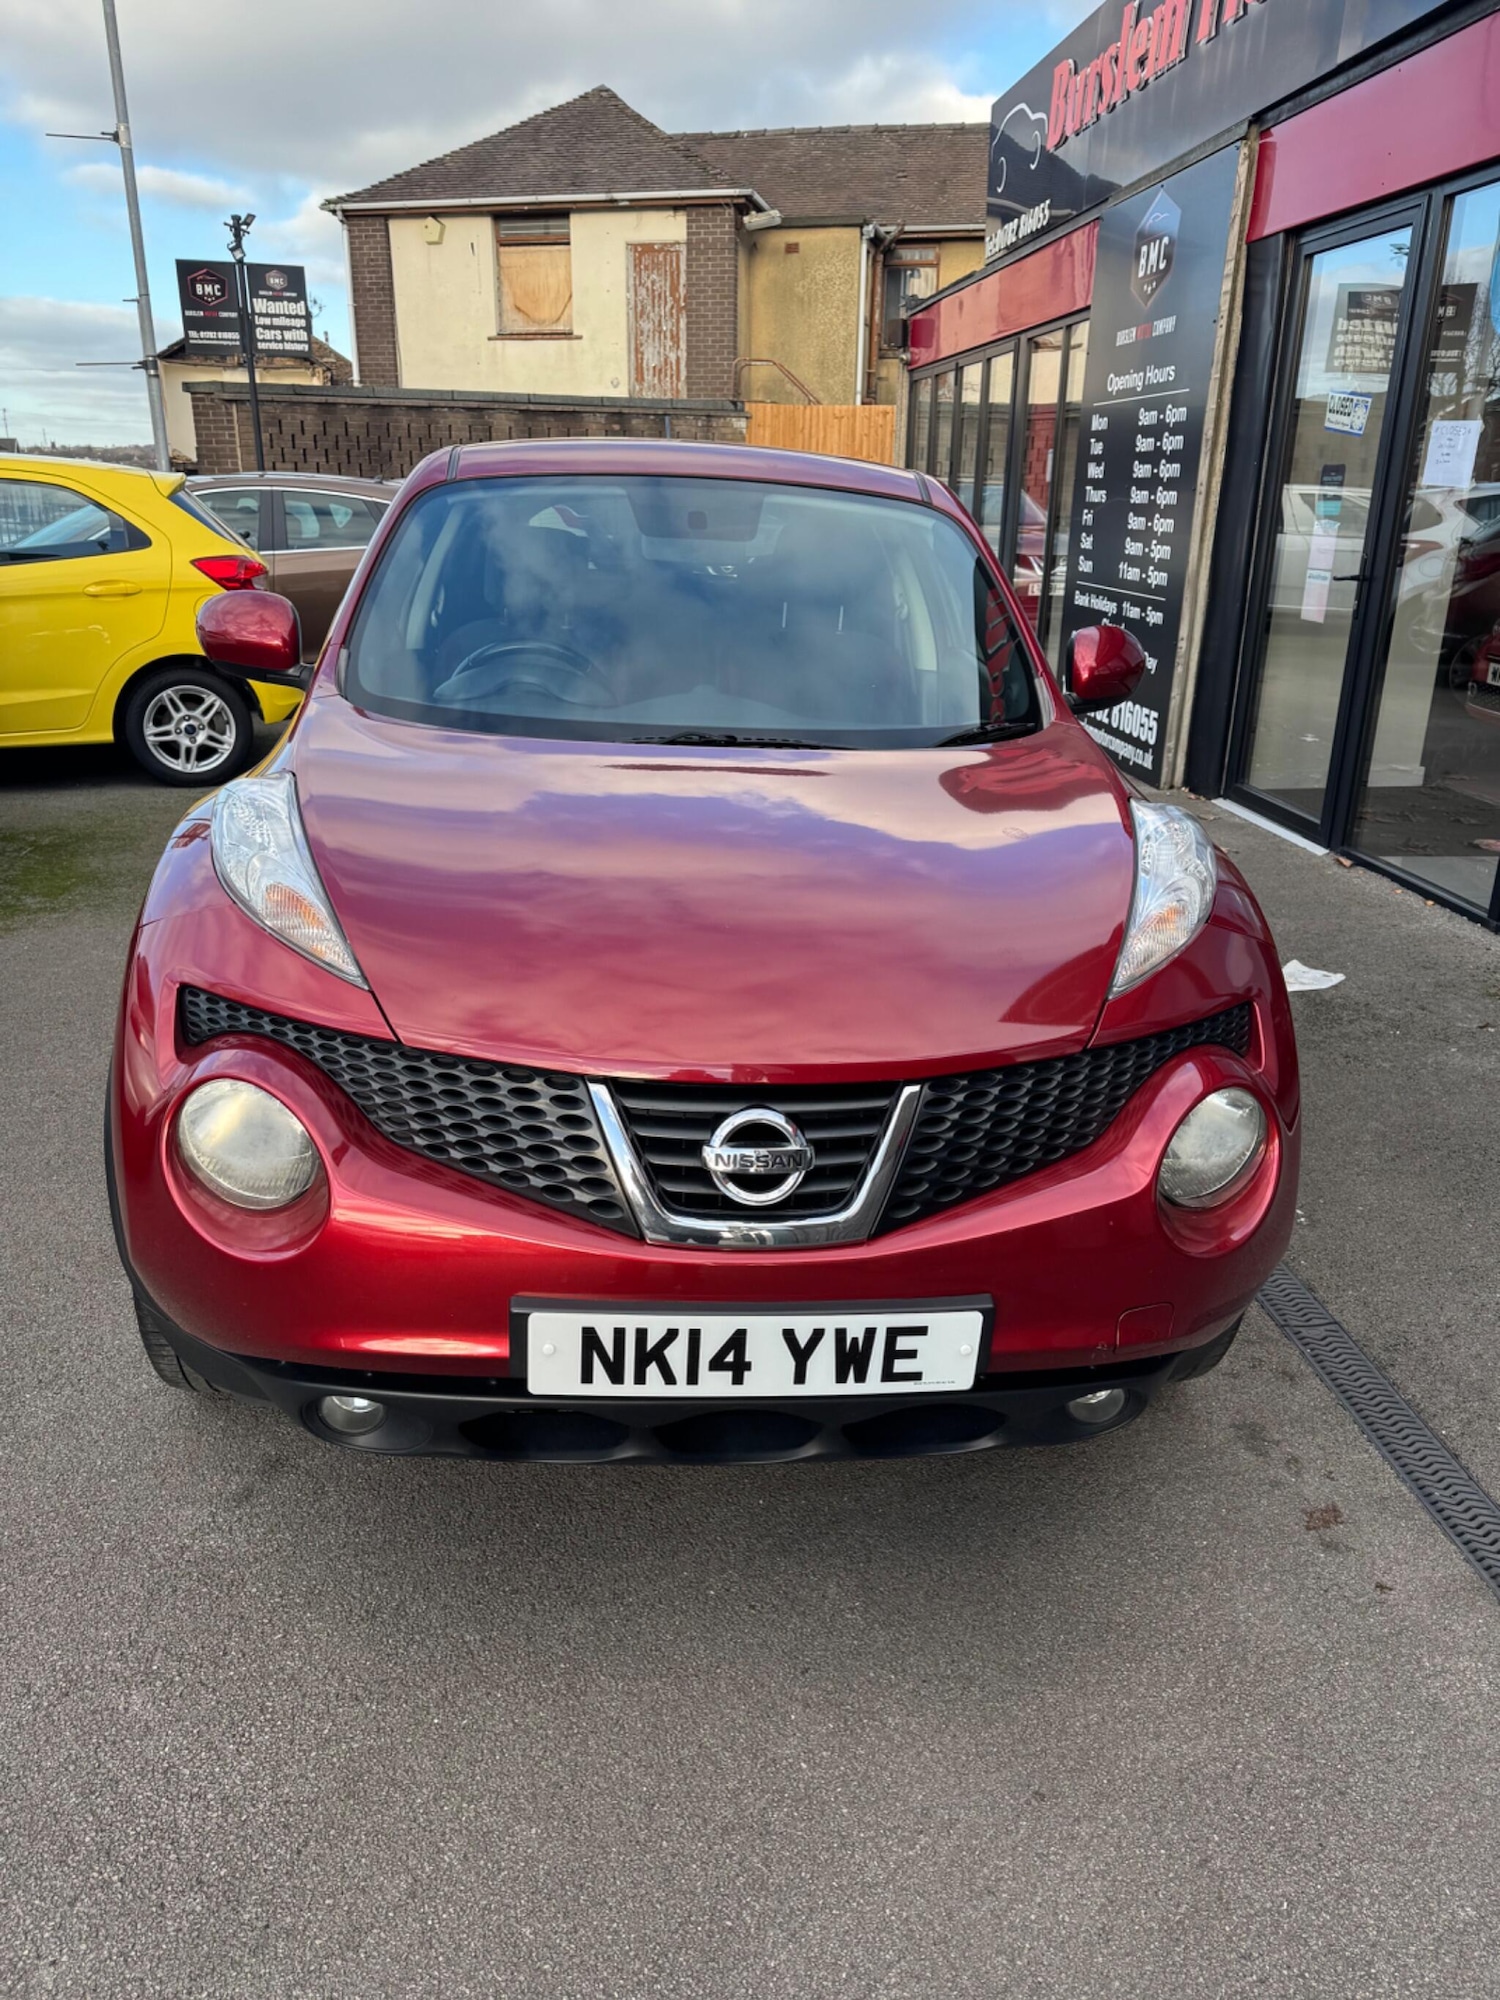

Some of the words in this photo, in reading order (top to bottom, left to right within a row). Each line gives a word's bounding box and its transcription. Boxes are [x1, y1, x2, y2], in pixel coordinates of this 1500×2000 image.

[1046, 0, 1191, 152] Burslem
[1138, 236, 1169, 278] BMC
[195, 283, 221, 296] BMC
[252, 298, 306, 315] Wanted
[254, 315, 271, 325] Low
[272, 316, 306, 327] mileage
[256, 327, 282, 340] Cars
[282, 328, 308, 341] with
[257, 342, 283, 350] service
[284, 342, 309, 352] history
[1107, 369, 1144, 395] Opening
[1145, 365, 1176, 385] Hours
[1091, 413, 1109, 431] Mon
[1138, 407, 1158, 426] 9am
[1165, 403, 1187, 428] 6pm
[1090, 438, 1104, 455] Tue
[1135, 434, 1155, 452] 9am
[1162, 431, 1184, 456] 6pm
[1087, 461, 1105, 479] Wed
[1132, 460, 1152, 478] 9am
[1159, 458, 1181, 483] 6pm
[1085, 485, 1107, 503] Thurs
[1130, 485, 1149, 504] 9am
[1156, 485, 1178, 510] 6pm
[1082, 509, 1094, 526] Fri
[1127, 511, 1146, 530] 9am
[1153, 513, 1175, 537] 6pm
[1080, 532, 1094, 550] Sat
[1124, 537, 1144, 556] 9am
[1150, 539, 1172, 563] 5pm
[1078, 555, 1093, 573] Sun
[1118, 561, 1141, 582] 11am
[1147, 566, 1168, 589] 5pm
[1074, 590, 1089, 608] Bank
[1090, 593, 1118, 617] Holidays
[1122, 601, 1141, 620] 11am
[1146, 606, 1164, 627] 5pm
[1111, 700, 1159, 745] 816055
[715, 1153, 802, 1169] NISSAN
[580, 1326, 752, 1386] NK14
[781, 1326, 929, 1386] YWE
